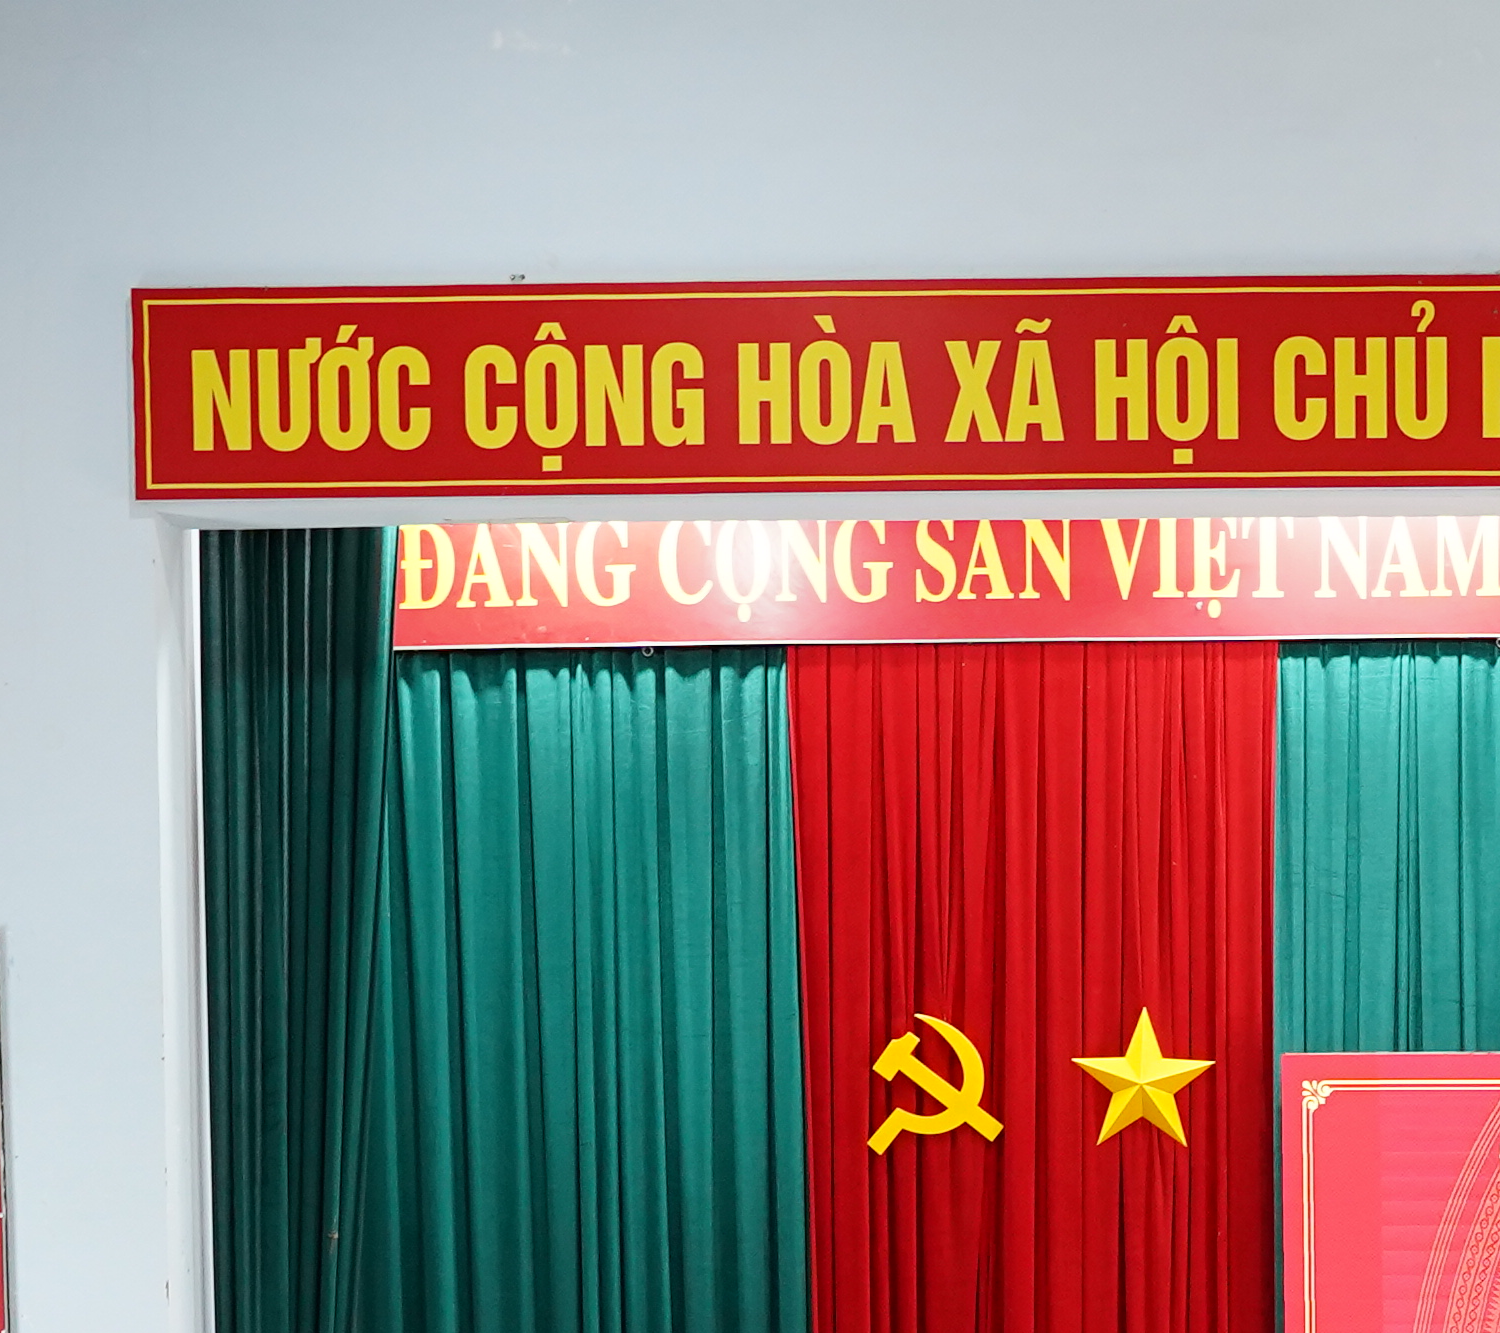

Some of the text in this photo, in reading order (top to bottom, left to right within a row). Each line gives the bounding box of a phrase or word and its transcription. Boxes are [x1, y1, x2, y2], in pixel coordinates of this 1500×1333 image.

[193, 325, 431, 452] NƯỚC
[464, 322, 705, 471] CỘNG
[737, 315, 918, 447] HÒA
[945, 318, 1064, 443] XÃ
[1094, 315, 1240, 464] HỘI
[1272, 300, 1447, 440] CHỦ
